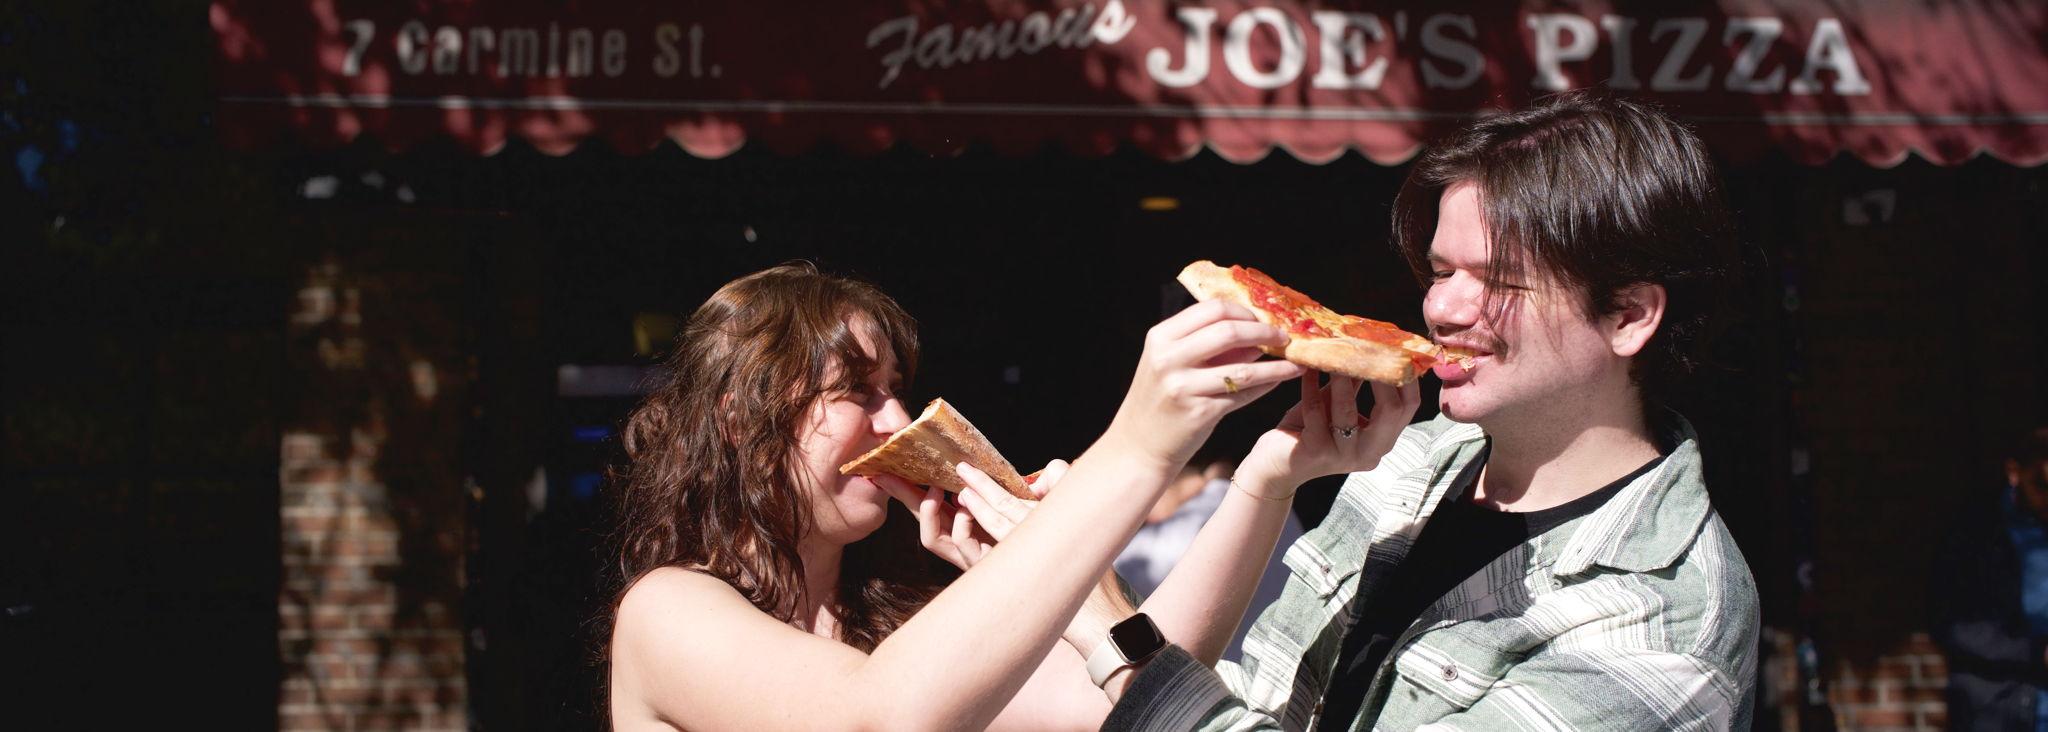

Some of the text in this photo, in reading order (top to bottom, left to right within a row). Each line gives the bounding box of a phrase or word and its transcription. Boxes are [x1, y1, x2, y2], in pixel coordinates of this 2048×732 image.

[341, 19, 723, 79] 7 Carmine St.
[865, 0, 1871, 95] Famous JOE'S PIZZA
